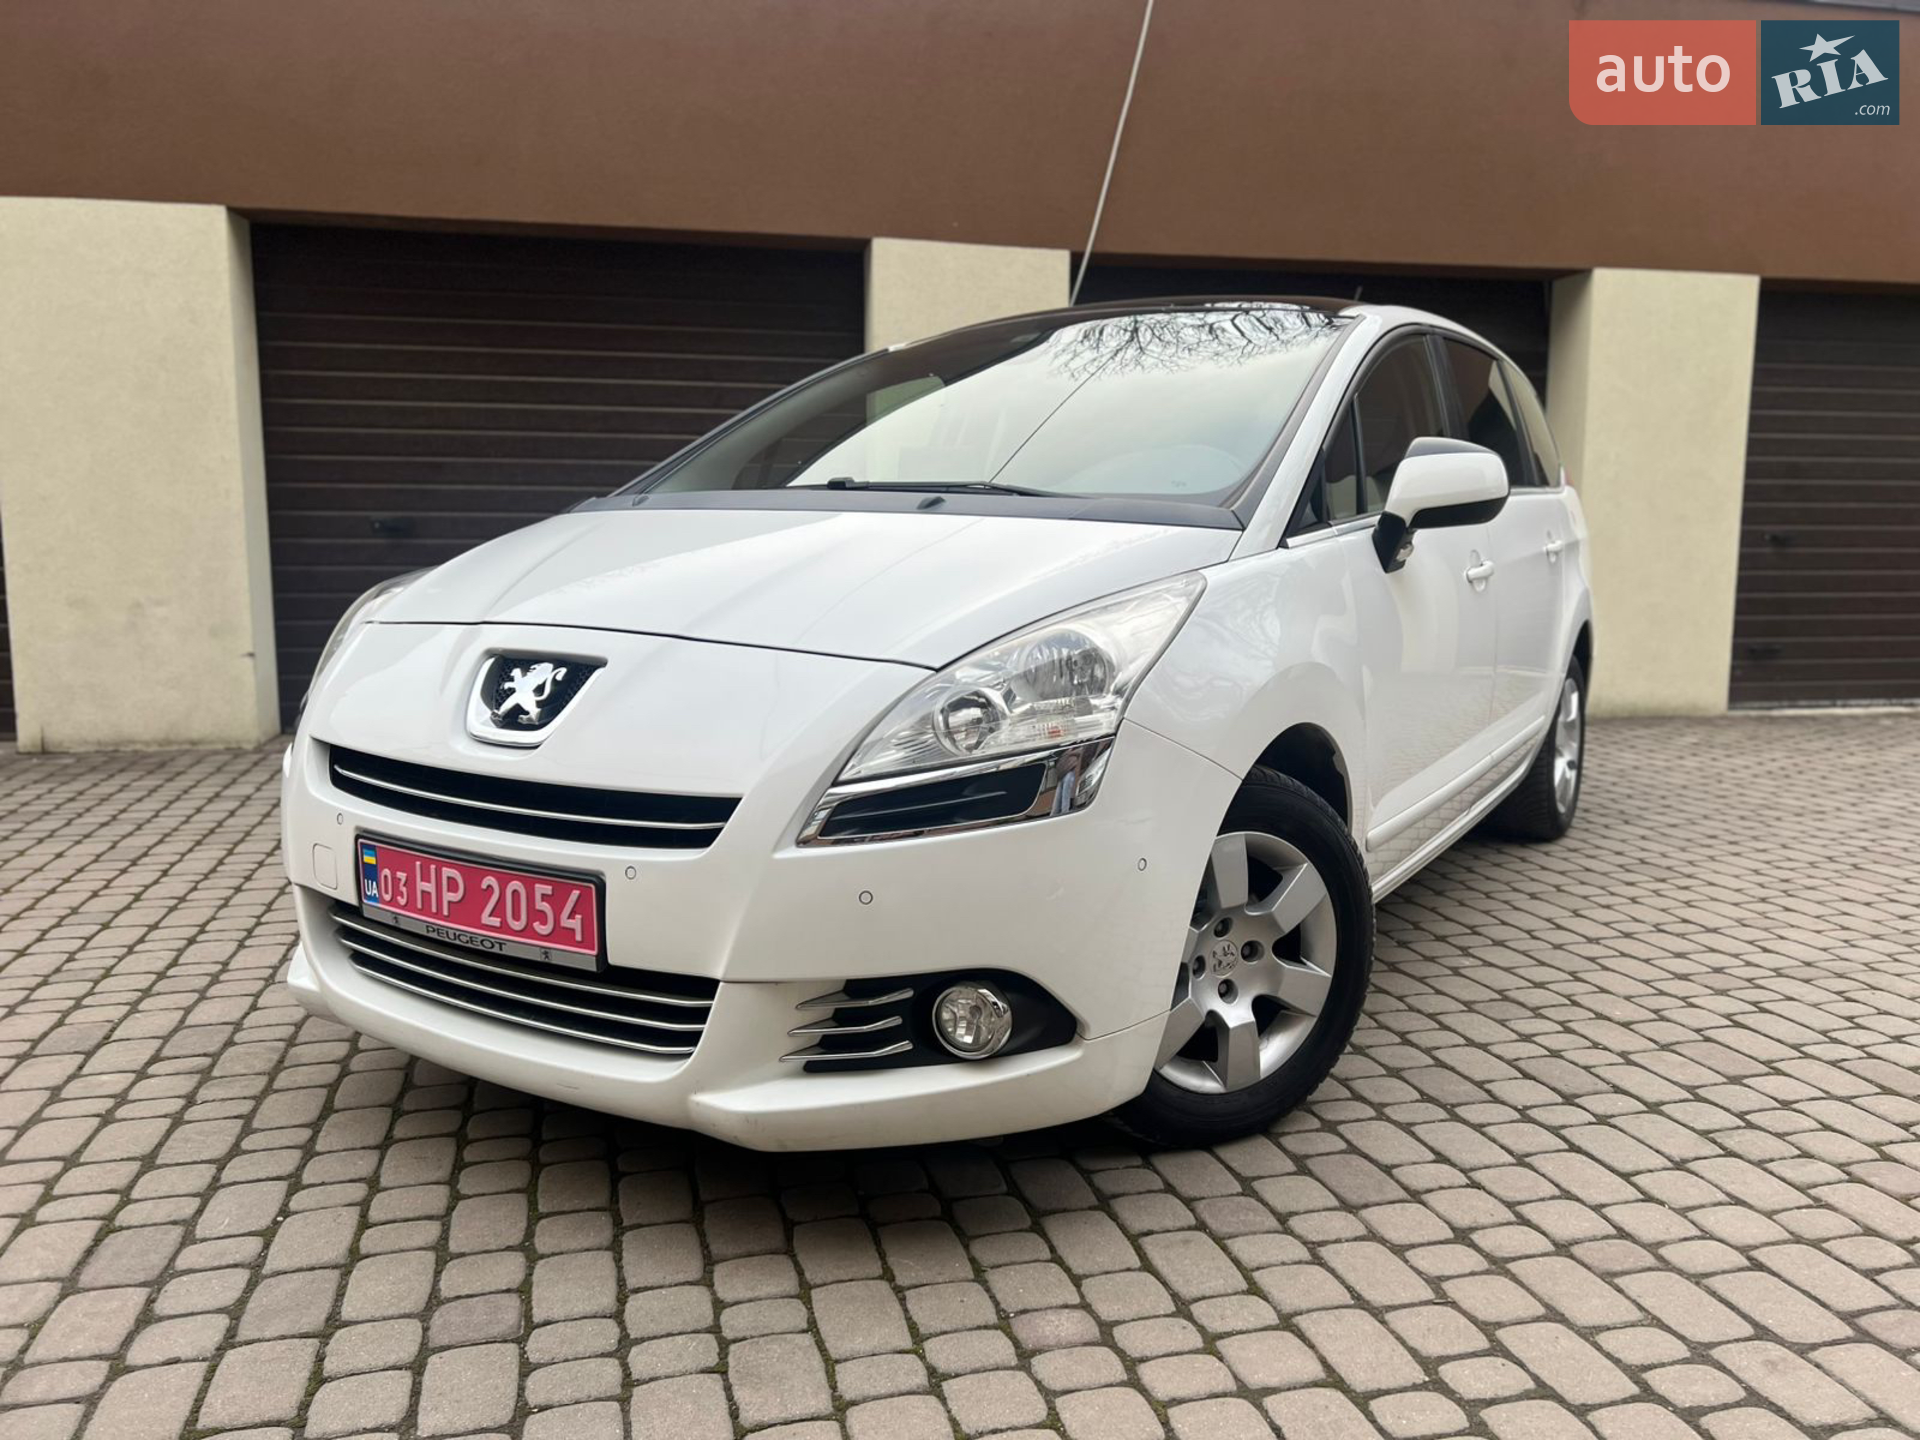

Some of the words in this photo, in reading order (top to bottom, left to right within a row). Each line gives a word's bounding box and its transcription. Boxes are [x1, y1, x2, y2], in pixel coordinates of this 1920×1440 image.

[364, 879, 379, 899] UA
[381, 867, 408, 906] 03
[415, 860, 465, 917] HP
[480, 875, 583, 942] 2054
[425, 924, 508, 951] PEUGEOT
